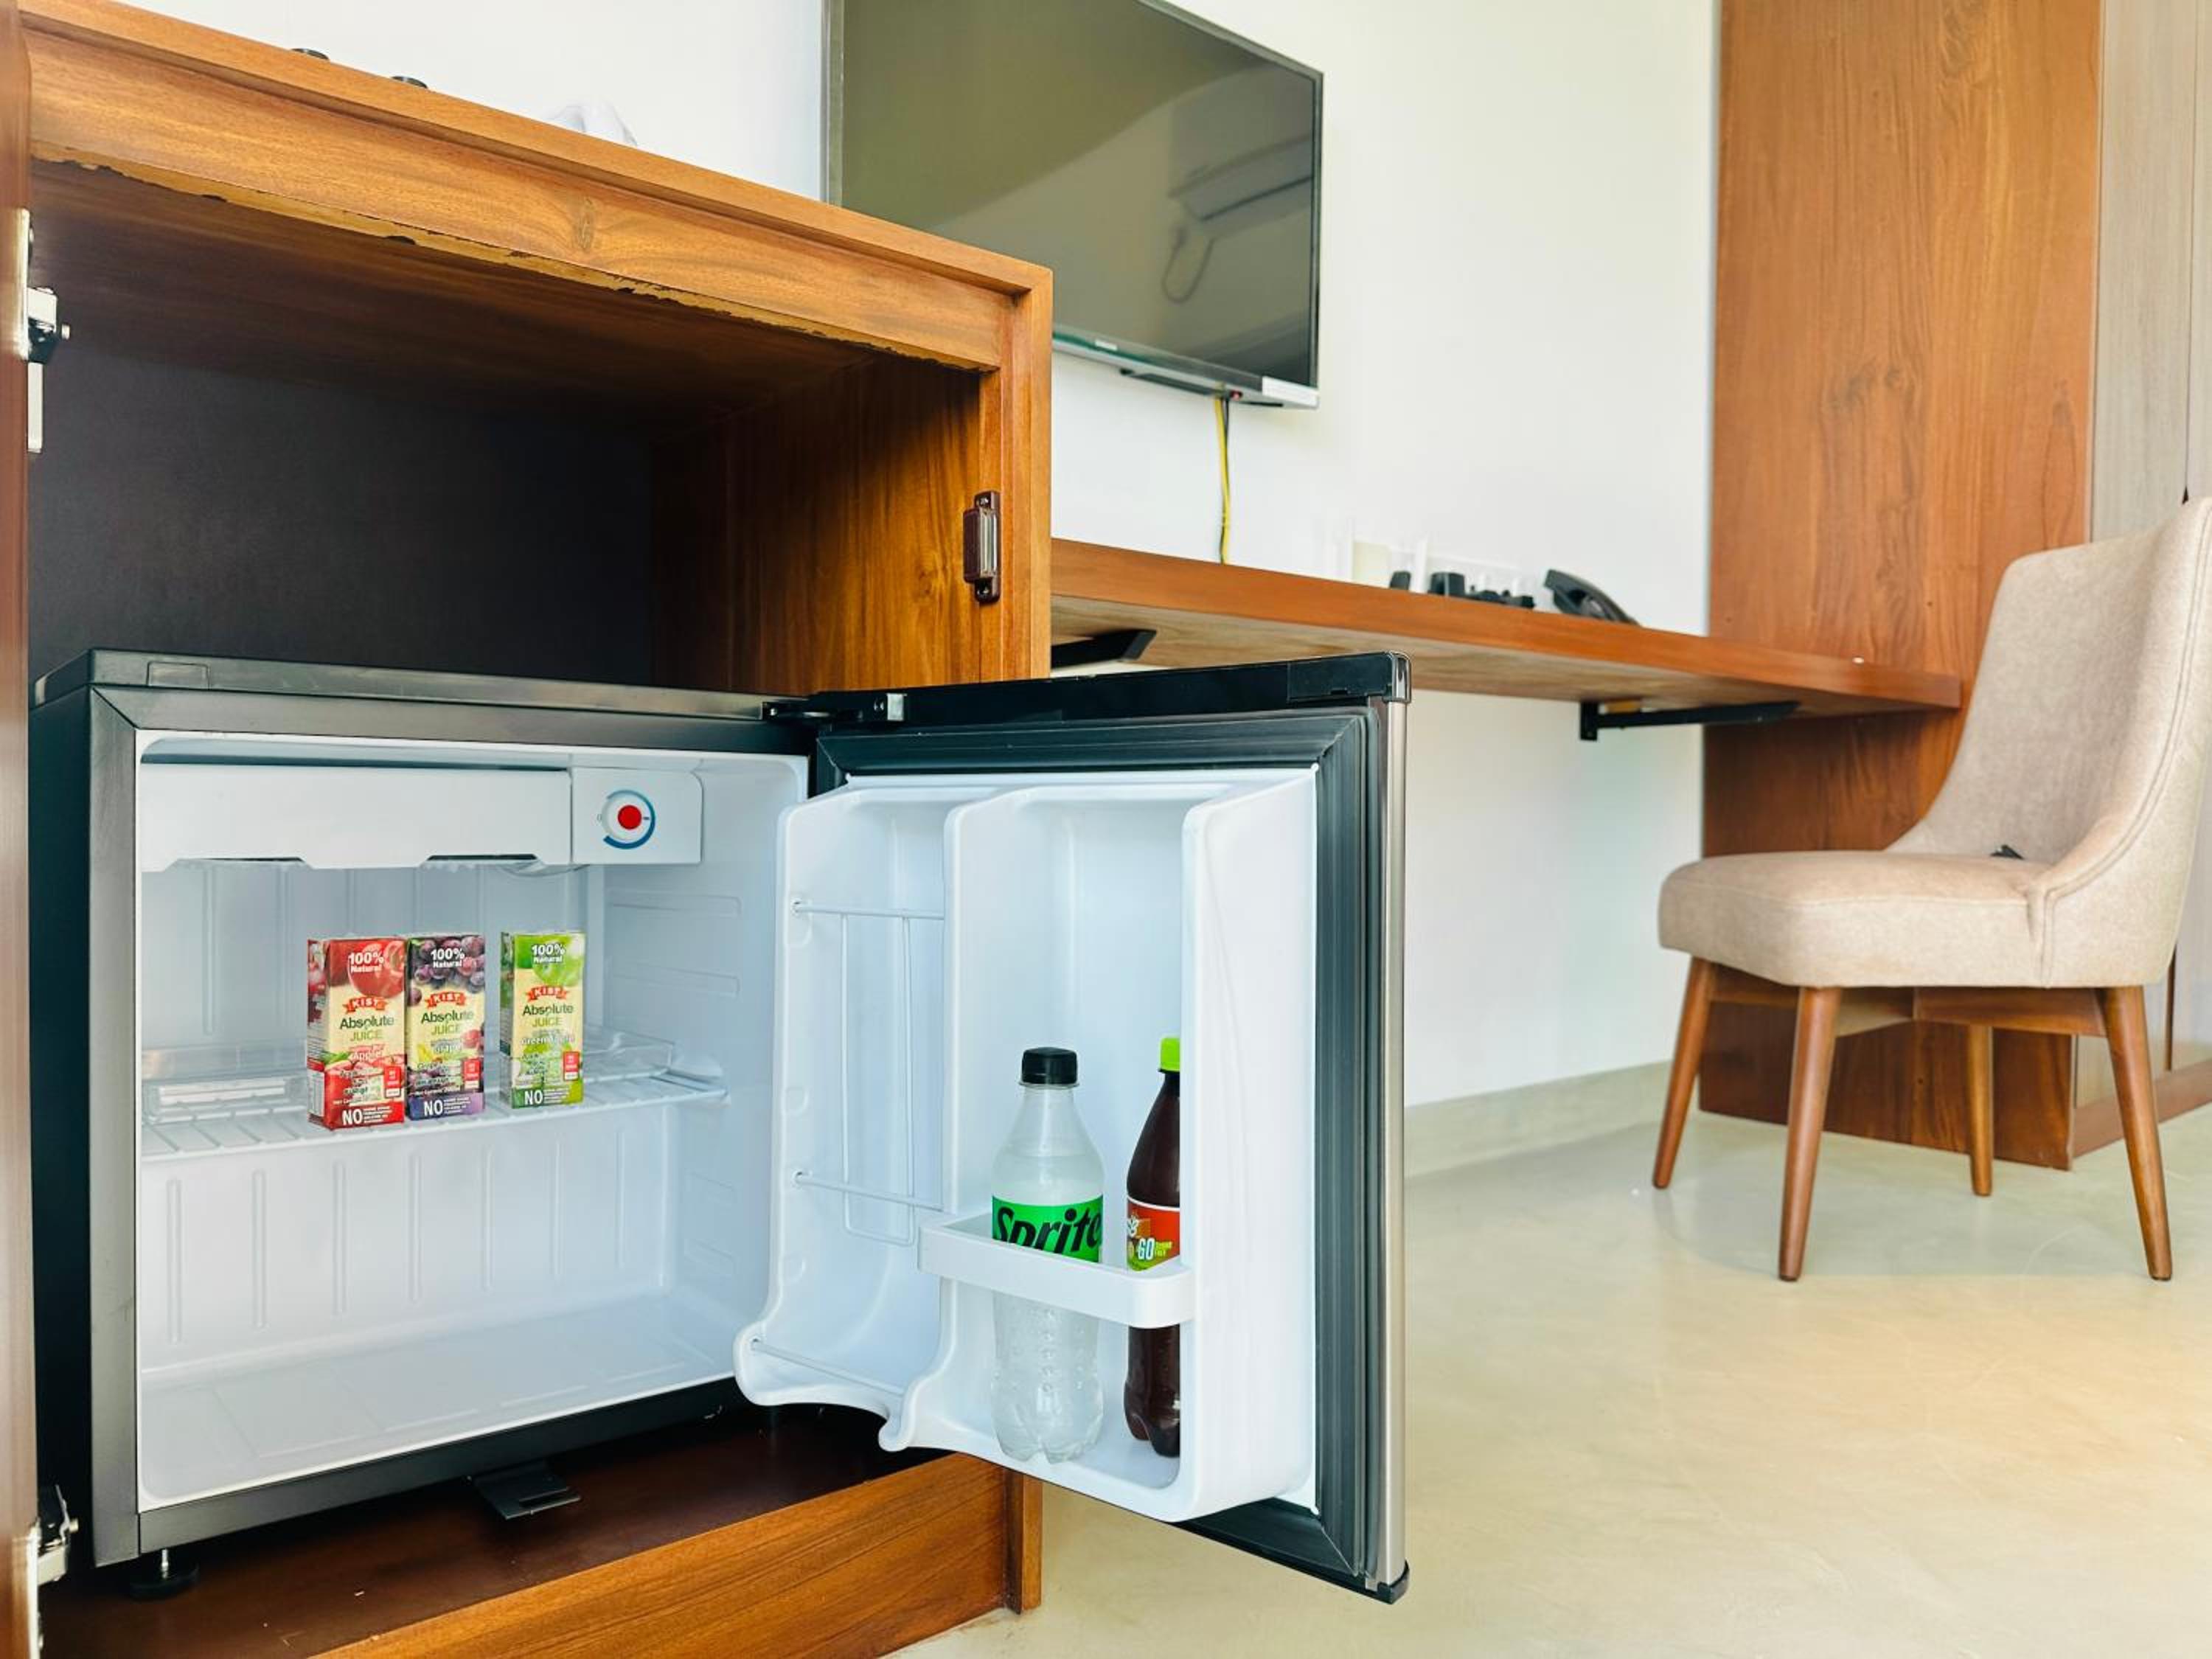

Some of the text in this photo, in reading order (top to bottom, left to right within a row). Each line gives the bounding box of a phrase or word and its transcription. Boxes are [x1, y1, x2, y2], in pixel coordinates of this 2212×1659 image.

[431, 948, 465, 961] 100%
[532, 945, 565, 956] 100%
[349, 952, 384, 964] 100%
[522, 1003, 574, 1016] Absolute
[340, 1015, 394, 1029] Absolute
[421, 1010, 473, 1024] Absolute
[532, 1017, 563, 1028] JUICE
[350, 1029, 381, 1042] JUICE
[431, 1023, 461, 1035] JUICE
[524, 1091, 543, 1105] NO
[424, 1100, 442, 1116] NO
[342, 1110, 362, 1124] NO
